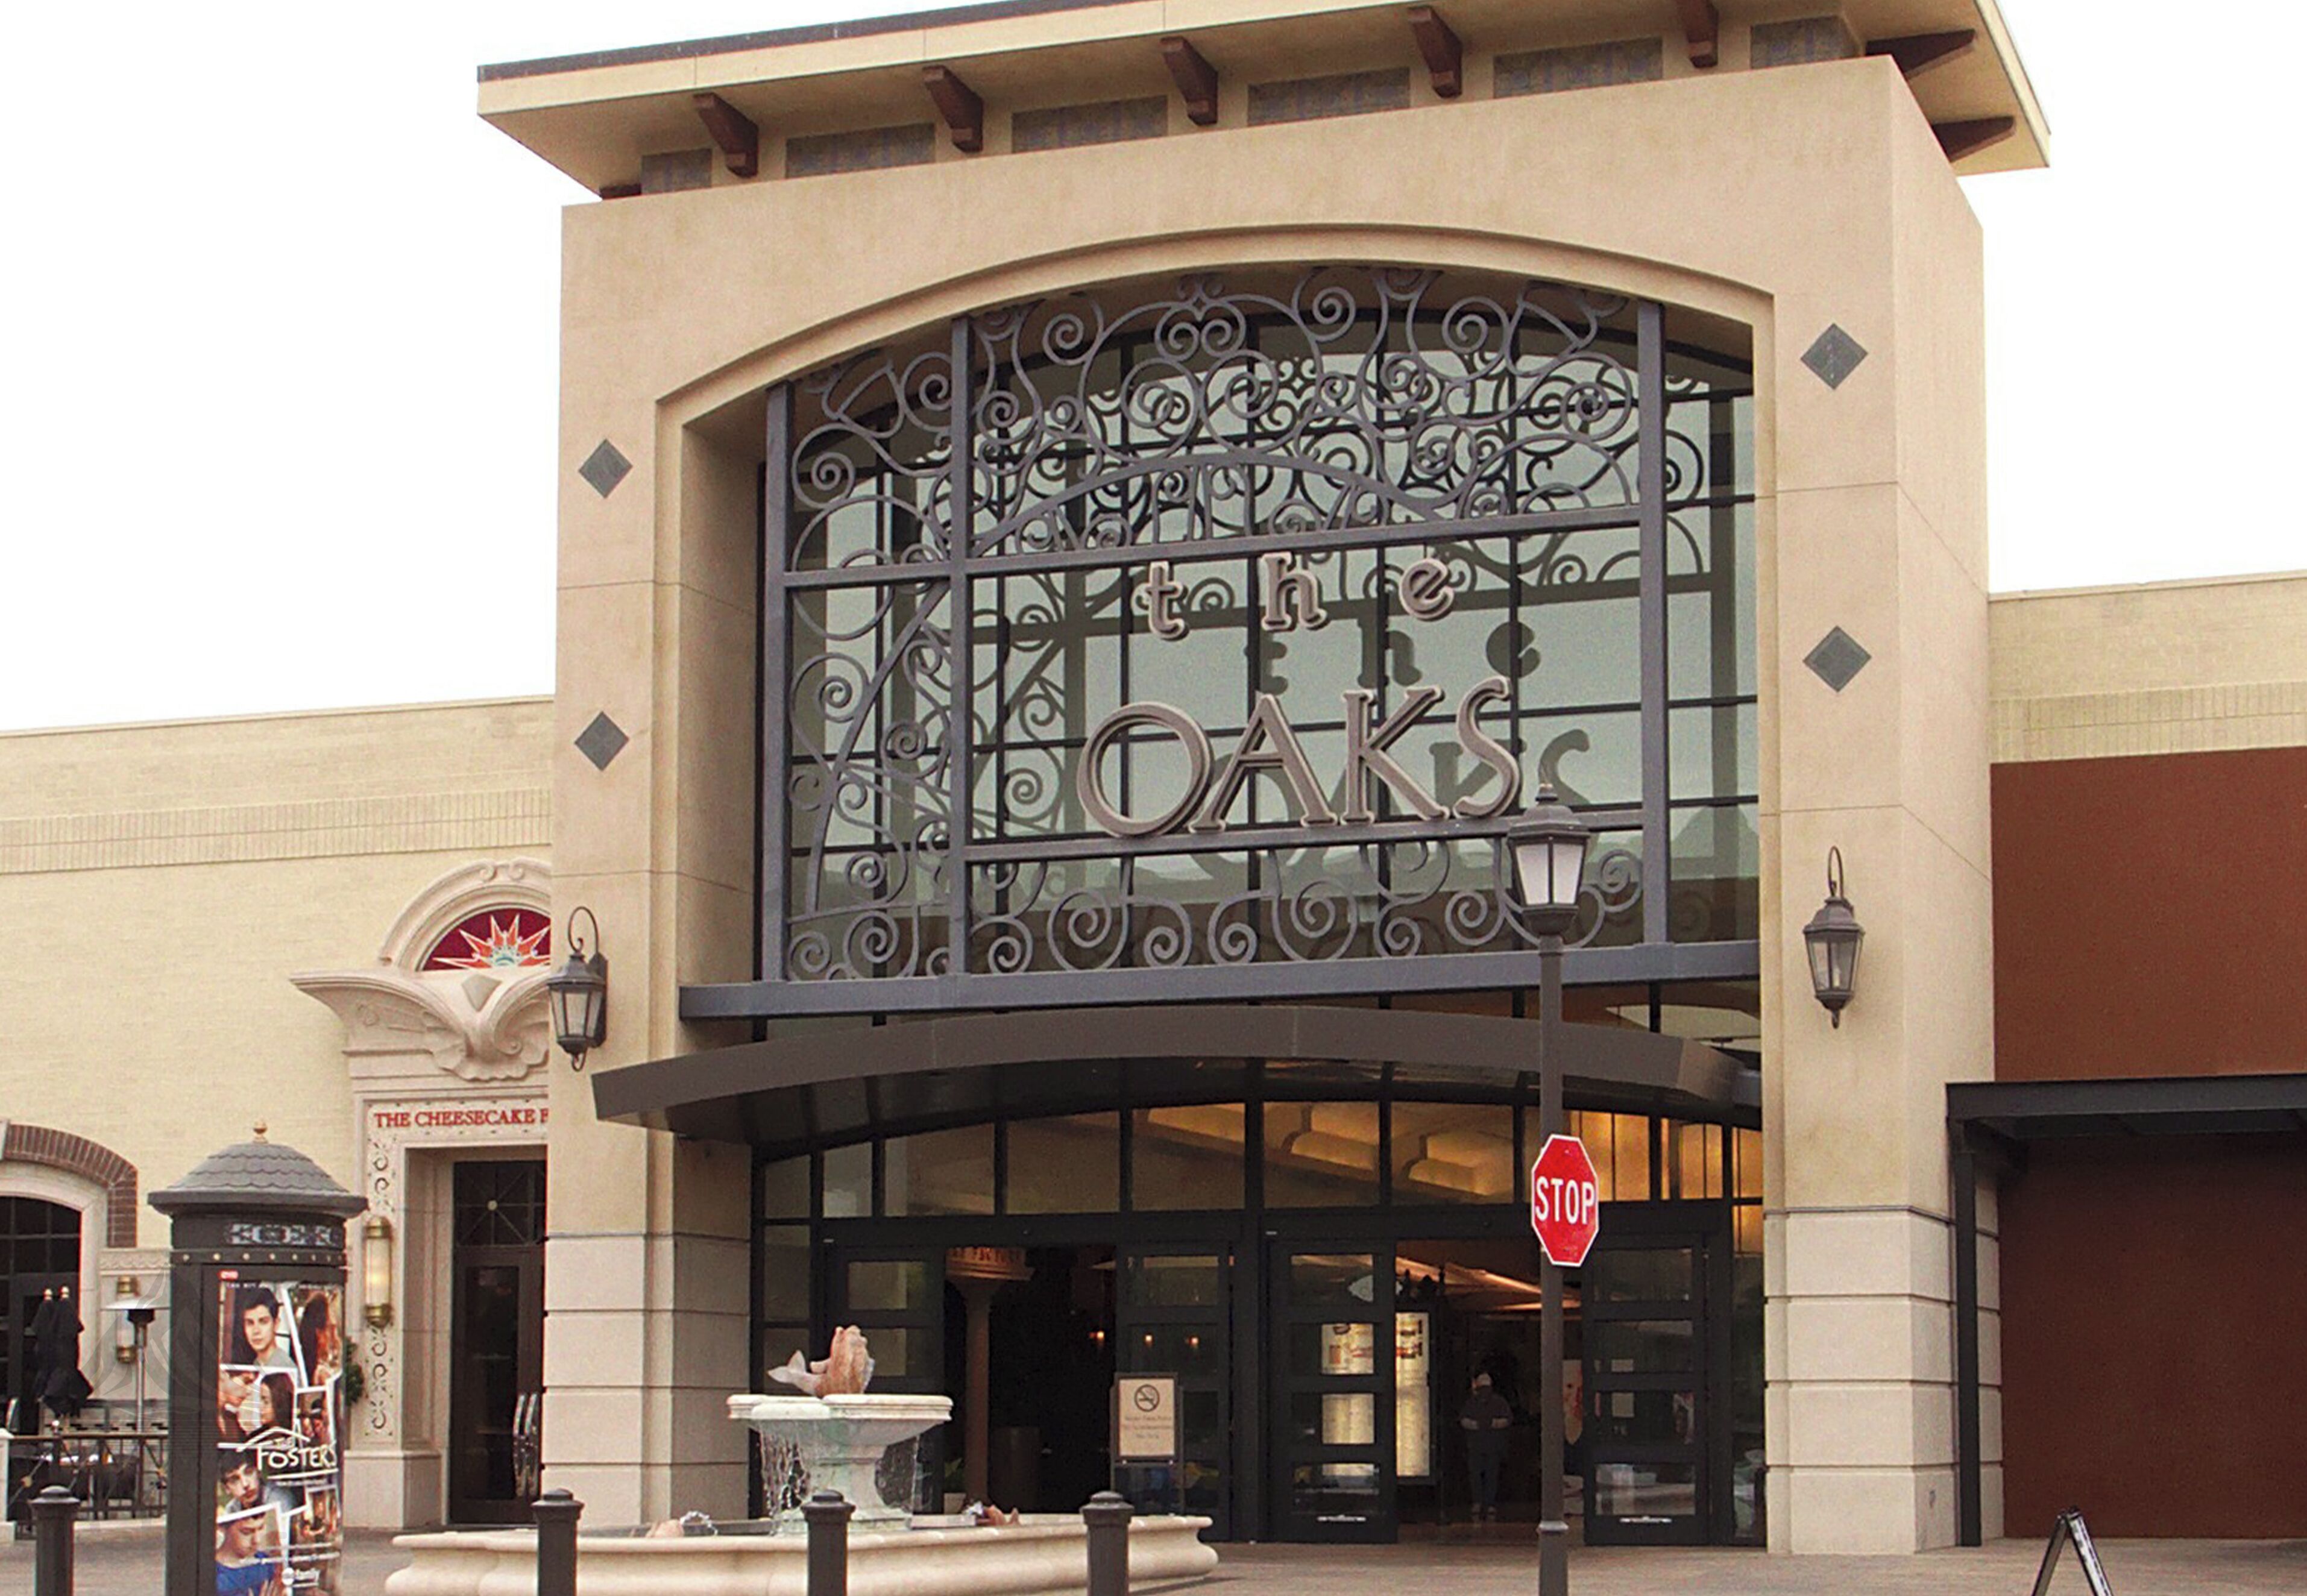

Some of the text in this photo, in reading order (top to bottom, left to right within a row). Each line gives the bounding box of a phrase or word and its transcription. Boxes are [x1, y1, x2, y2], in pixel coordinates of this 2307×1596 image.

[1144, 551, 1455, 641] the
[1077, 676, 1522, 837] OAKS
[374, 1112, 411, 1128] THE
[414, 1108, 536, 1126] CHEESECAKE
[1535, 1176, 1595, 1225] STOP
